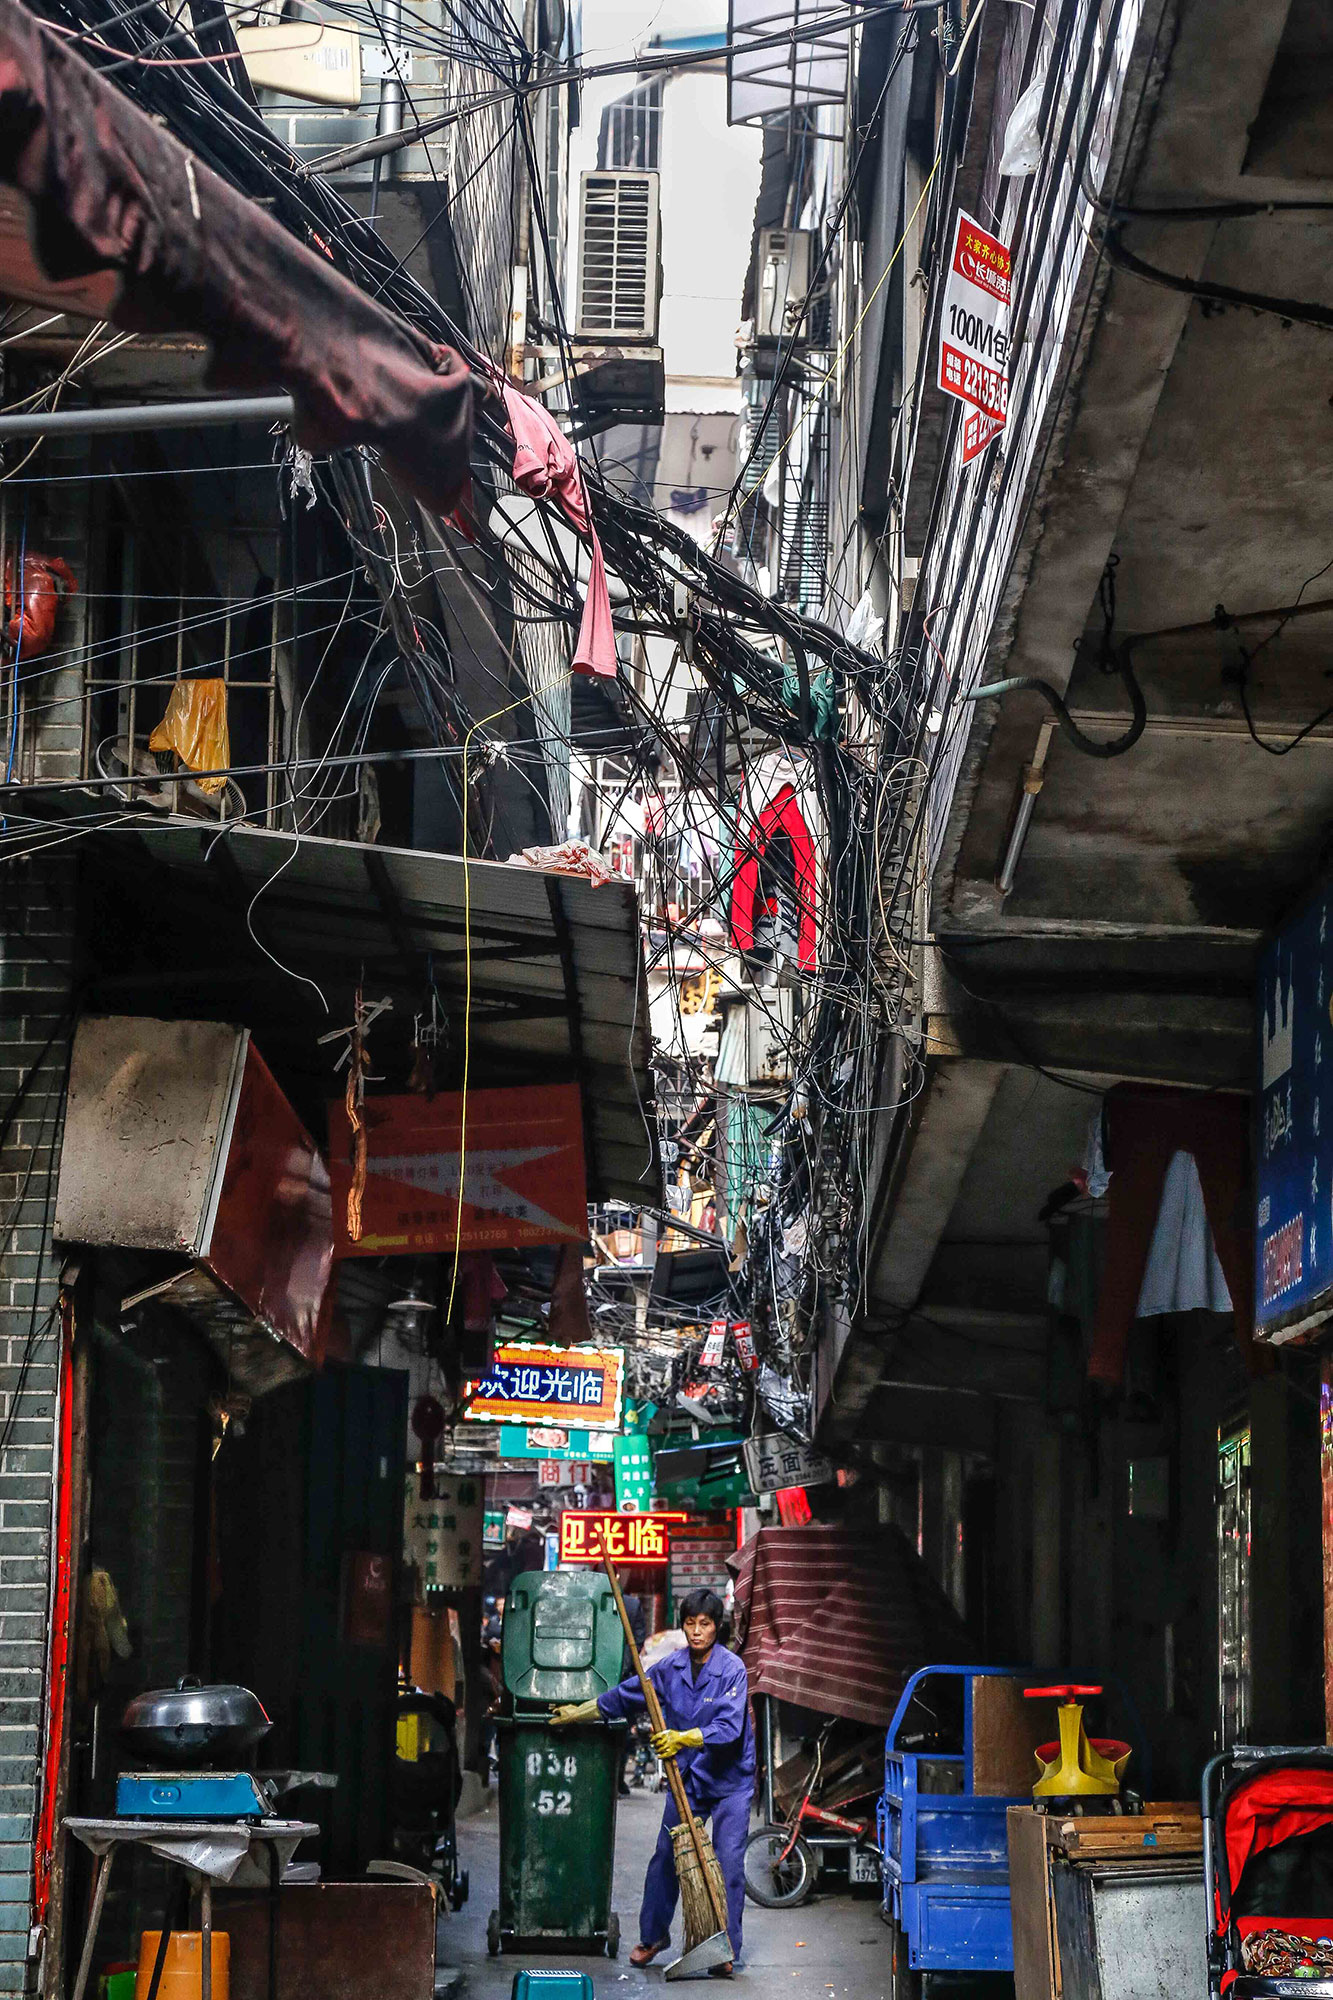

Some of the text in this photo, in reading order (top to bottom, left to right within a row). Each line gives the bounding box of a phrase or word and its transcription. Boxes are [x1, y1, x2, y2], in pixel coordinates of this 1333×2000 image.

[950, 303, 1010, 366] 100M包
[945, 367, 962, 386] 电话
[444, 1229, 508, 1243] 1325112769
[537, 1789, 572, 1816] 52
